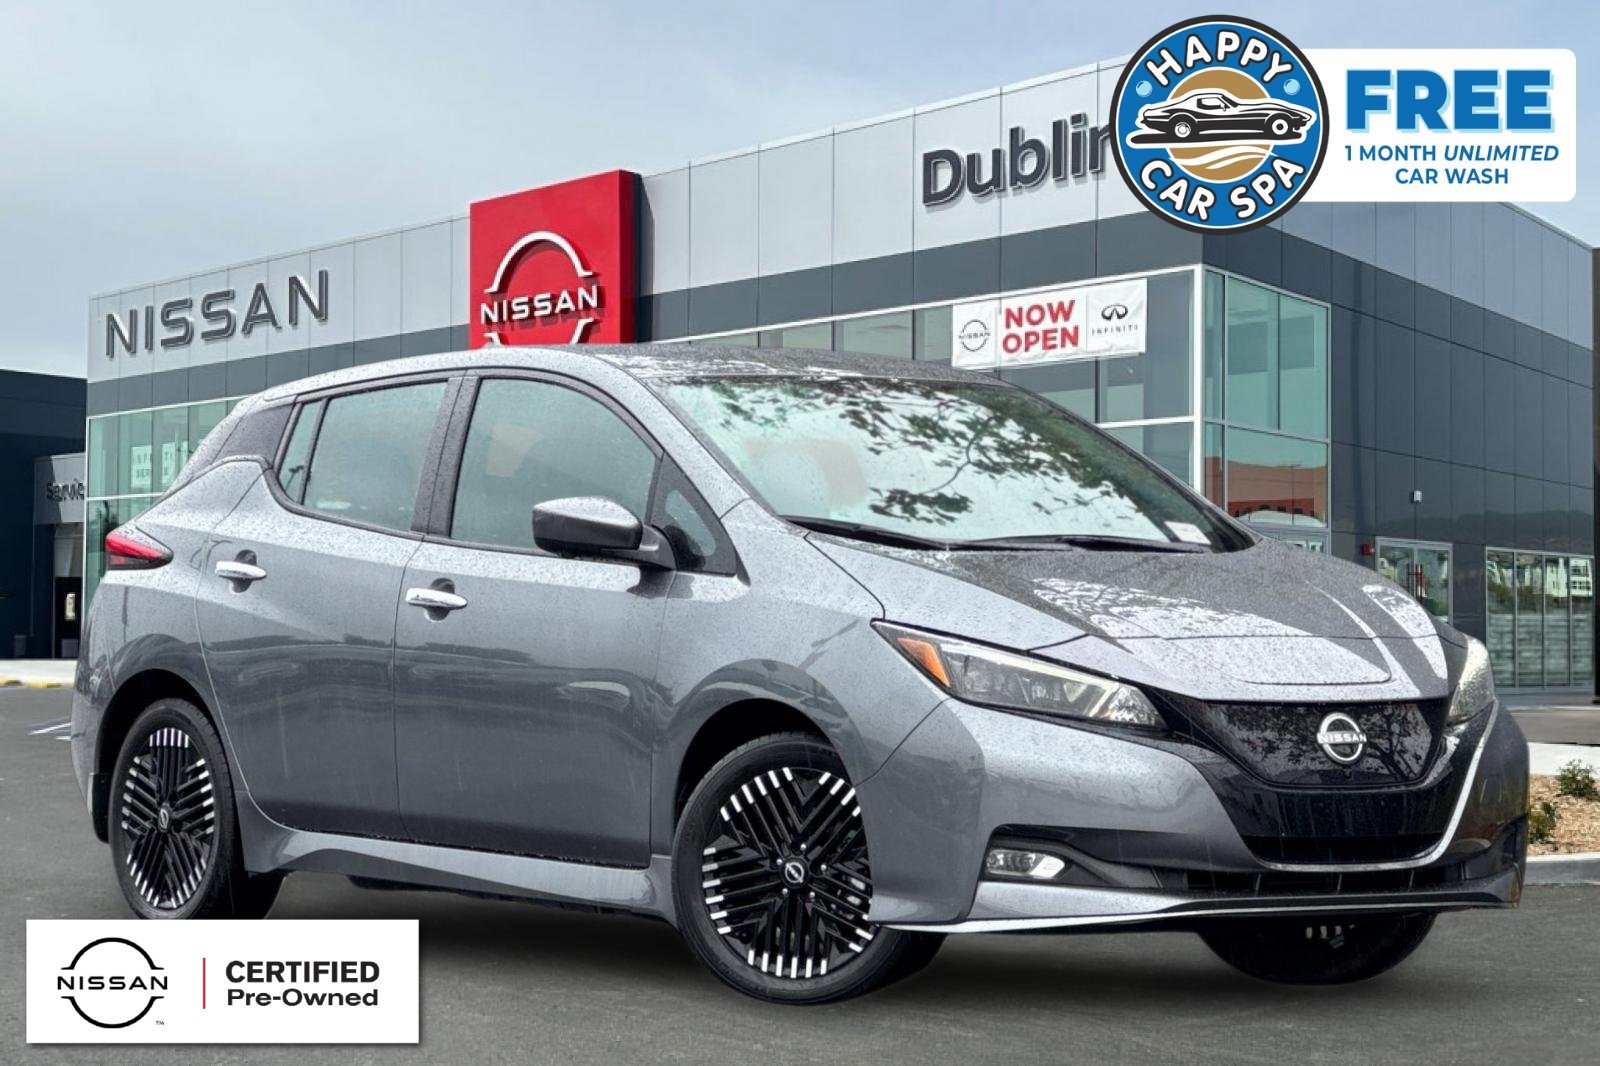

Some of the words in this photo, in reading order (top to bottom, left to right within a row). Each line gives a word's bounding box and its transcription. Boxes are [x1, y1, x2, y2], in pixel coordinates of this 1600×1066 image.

[105, 269, 329, 359] NISSAN
[480, 285, 599, 324] NISSAN
[1005, 299, 1075, 329] NOW
[1002, 324, 1080, 354] OPEN
[1091, 323, 1139, 336] INFINITI
[1316, 731, 1367, 745] NISSAN
